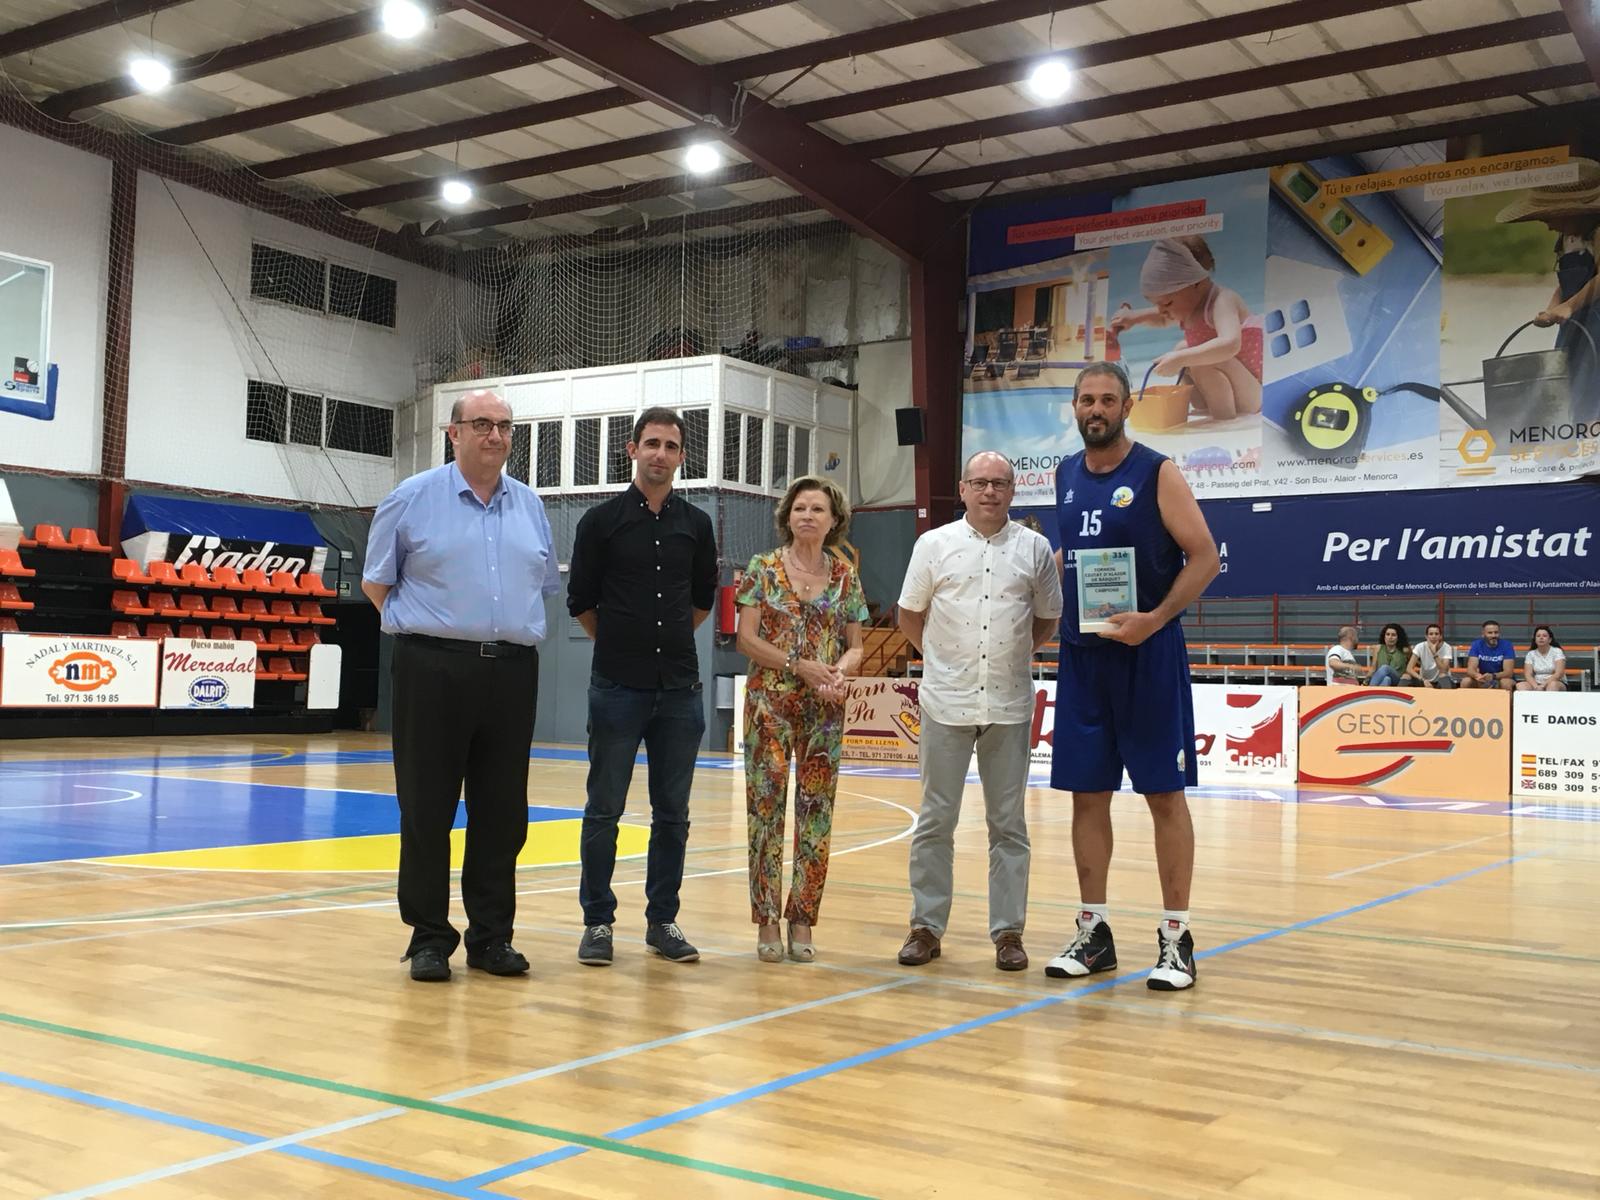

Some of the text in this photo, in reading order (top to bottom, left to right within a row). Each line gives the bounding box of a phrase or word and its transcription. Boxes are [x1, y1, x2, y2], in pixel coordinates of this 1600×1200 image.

[1341, 183, 1351, 193] te
[1355, 178, 1395, 191] relajas,
[1399, 169, 1451, 185] nosotros
[1455, 165, 1476, 177] nos
[1429, 185, 1451, 197] You
[1514, 172, 1540, 184] take
[1098, 231, 1128, 245] perfect
[1169, 222, 1184, 232] our
[1186, 217, 1220, 232] priority
[1277, 451, 1424, 467] www.menorcaservices.es
[1510, 466, 1535, 474] Home
[1558, 463, 1566, 471] &
[1211, 481, 1239, 489] Passeig
[1241, 479, 1253, 487] del
[1295, 477, 1310, 485] Son
[1312, 476, 1327, 484] Bou
[1334, 474, 1356, 482] Alaior
[1363, 472, 1398, 481] Menorca
[1079, 509, 1102, 537] 15
[1322, 531, 1390, 562] Per
[1339, 584, 1359, 592] suport
[190, 639, 212, 650] Queso
[25, 644, 61, 668] NADAL
[62, 641, 70, 651] Y
[164, 651, 256, 673] Mercadal
[65, 663, 101, 680] nm
[45, 694, 119, 703] Tel. 971 36 19 85
[193, 684, 224, 698] DALRIT
[847, 700, 875, 725] Pa
[1521, 714, 1597, 726] TE DAMOS
[1337, 709, 1504, 740] GESTIÓ2000
[1226, 749, 1282, 768] Crisol
[1538, 769, 1557, 778] 689
[1564, 771, 1584, 779] 309
[1538, 782, 1557, 791] 689
[1564, 784, 1584, 792] 309
